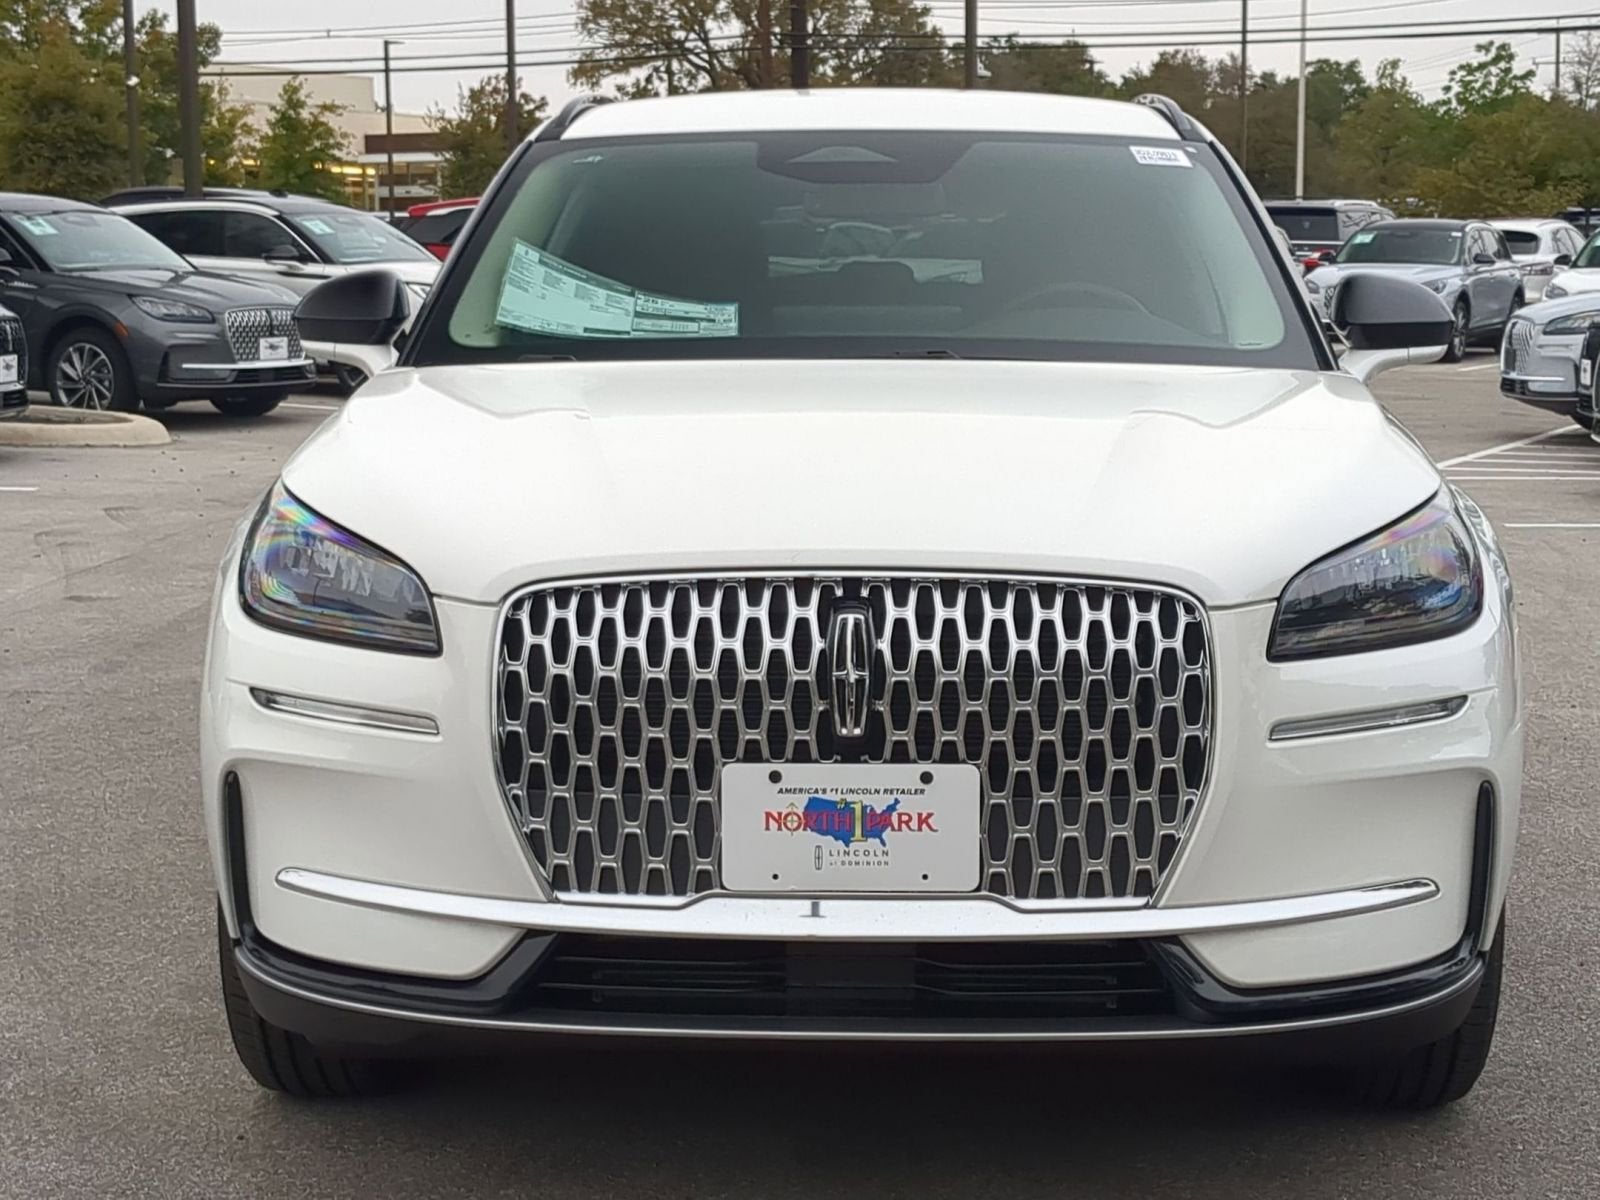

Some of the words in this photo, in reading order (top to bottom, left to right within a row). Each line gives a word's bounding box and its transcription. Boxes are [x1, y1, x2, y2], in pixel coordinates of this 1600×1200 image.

[777, 787, 827, 795] AMERICA'S
[840, 787, 881, 796] LINCOLN
[883, 788, 926, 796] RETAILER
[764, 811, 851, 832] NORTH
[866, 812, 938, 833] PARK
